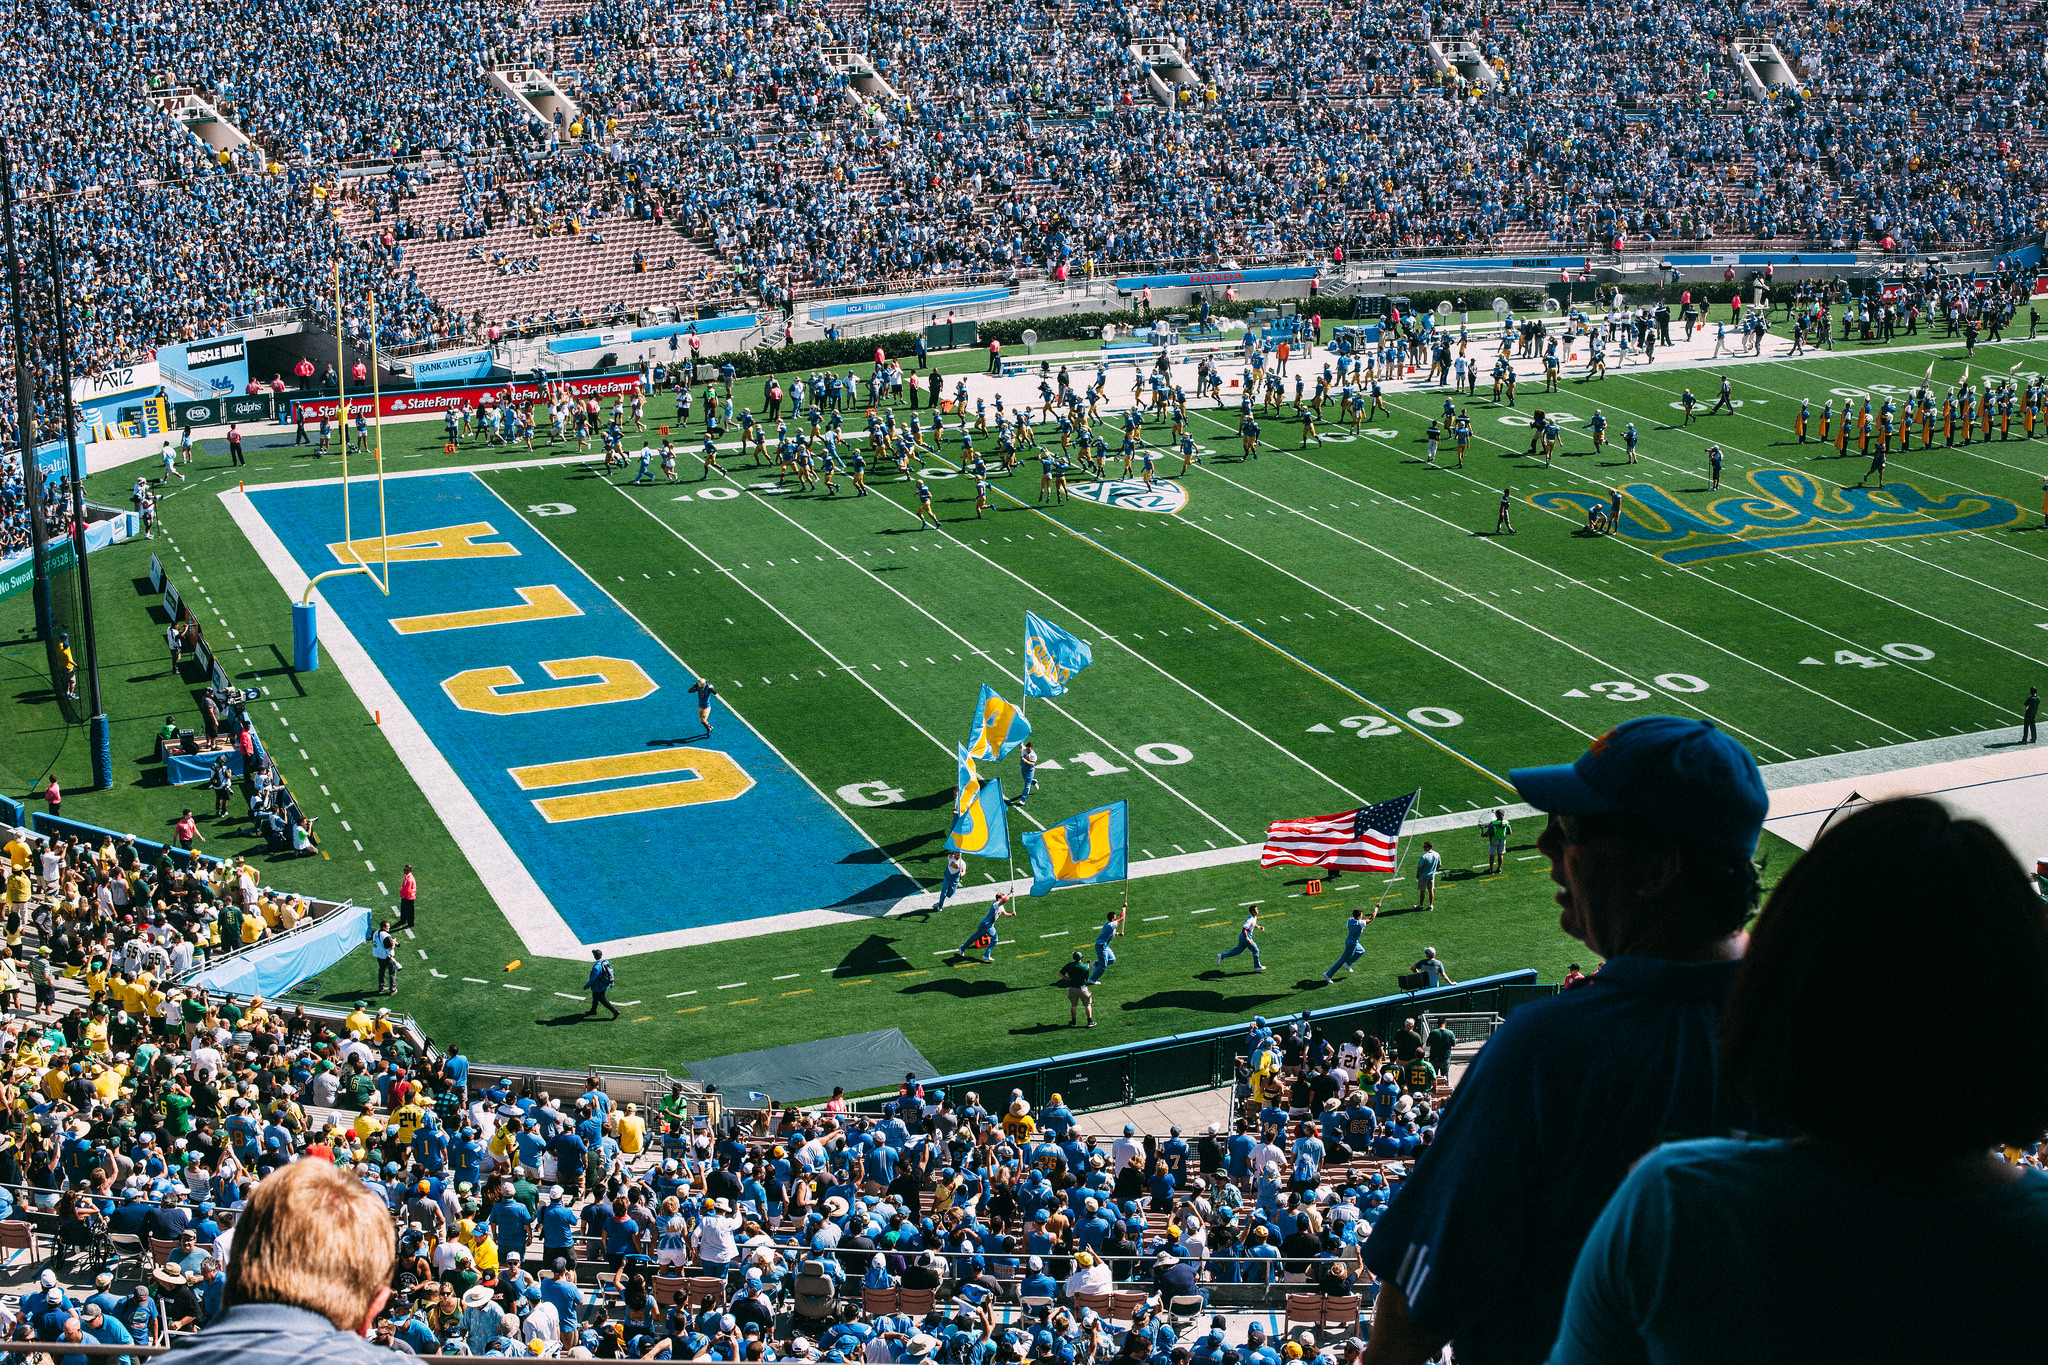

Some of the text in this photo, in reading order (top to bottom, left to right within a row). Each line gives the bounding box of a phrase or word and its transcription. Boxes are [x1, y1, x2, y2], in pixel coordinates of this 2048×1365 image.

[1147, 46, 1155, 55] 4
[1448, 44, 1455, 53] 3
[1751, 45, 1758, 53] 2
[835, 57, 843, 66] 5
[512, 72, 521, 82] 6
[170, 98, 179, 110] 7
[1512, 258, 1551, 268] MUSCLE MILK
[1189, 272, 1245, 283] HONDA
[865, 302, 886, 311] Health
[264, 328, 274, 337] 7A
[187, 343, 243, 365] MUSCLE MILK
[419, 362, 442, 373] BANK
[449, 356, 473, 367] WEST
[191, 408, 206, 417] FOX
[234, 402, 262, 414] Ralphs
[144, 400, 161, 434] NOISE
[661, 427, 669, 435] 10
[447, 444, 454, 453] G
[526, 502, 578, 517] G
[10, 568, 34, 588] Sweat
[1834, 642, 1936, 669] 40
[326, 521, 757, 823] UCLA
[1589, 673, 1710, 702] 30
[1338, 706, 1465, 739] 20
[1069, 742, 1194, 777] 10
[835, 779, 905, 807] G
[1040, 808, 1113, 882] U
[1308, 880, 1322, 893] 10
[127, 944, 139, 960] 55
[148, 952, 161, 965] 55
[1343, 1054, 1358, 1070] 21
[350, 1076, 360, 1093] 6
[1411, 1071, 1426, 1085] 25
[1381, 1093, 1391, 1105] 11
[160, 1100, 168, 1116] 6
[399, 1112, 417, 1128] 24
[902, 1109, 918, 1124] 15
[1350, 1120, 1369, 1134] 65
[232, 1129, 245, 1148] 8
[423, 1139, 430, 1156] 1
[72, 1152, 80, 1169] 1
[461, 1153, 468, 1169] 1
[1039, 1155, 1058, 1170] 26
[1169, 1154, 1182, 1170] 7
